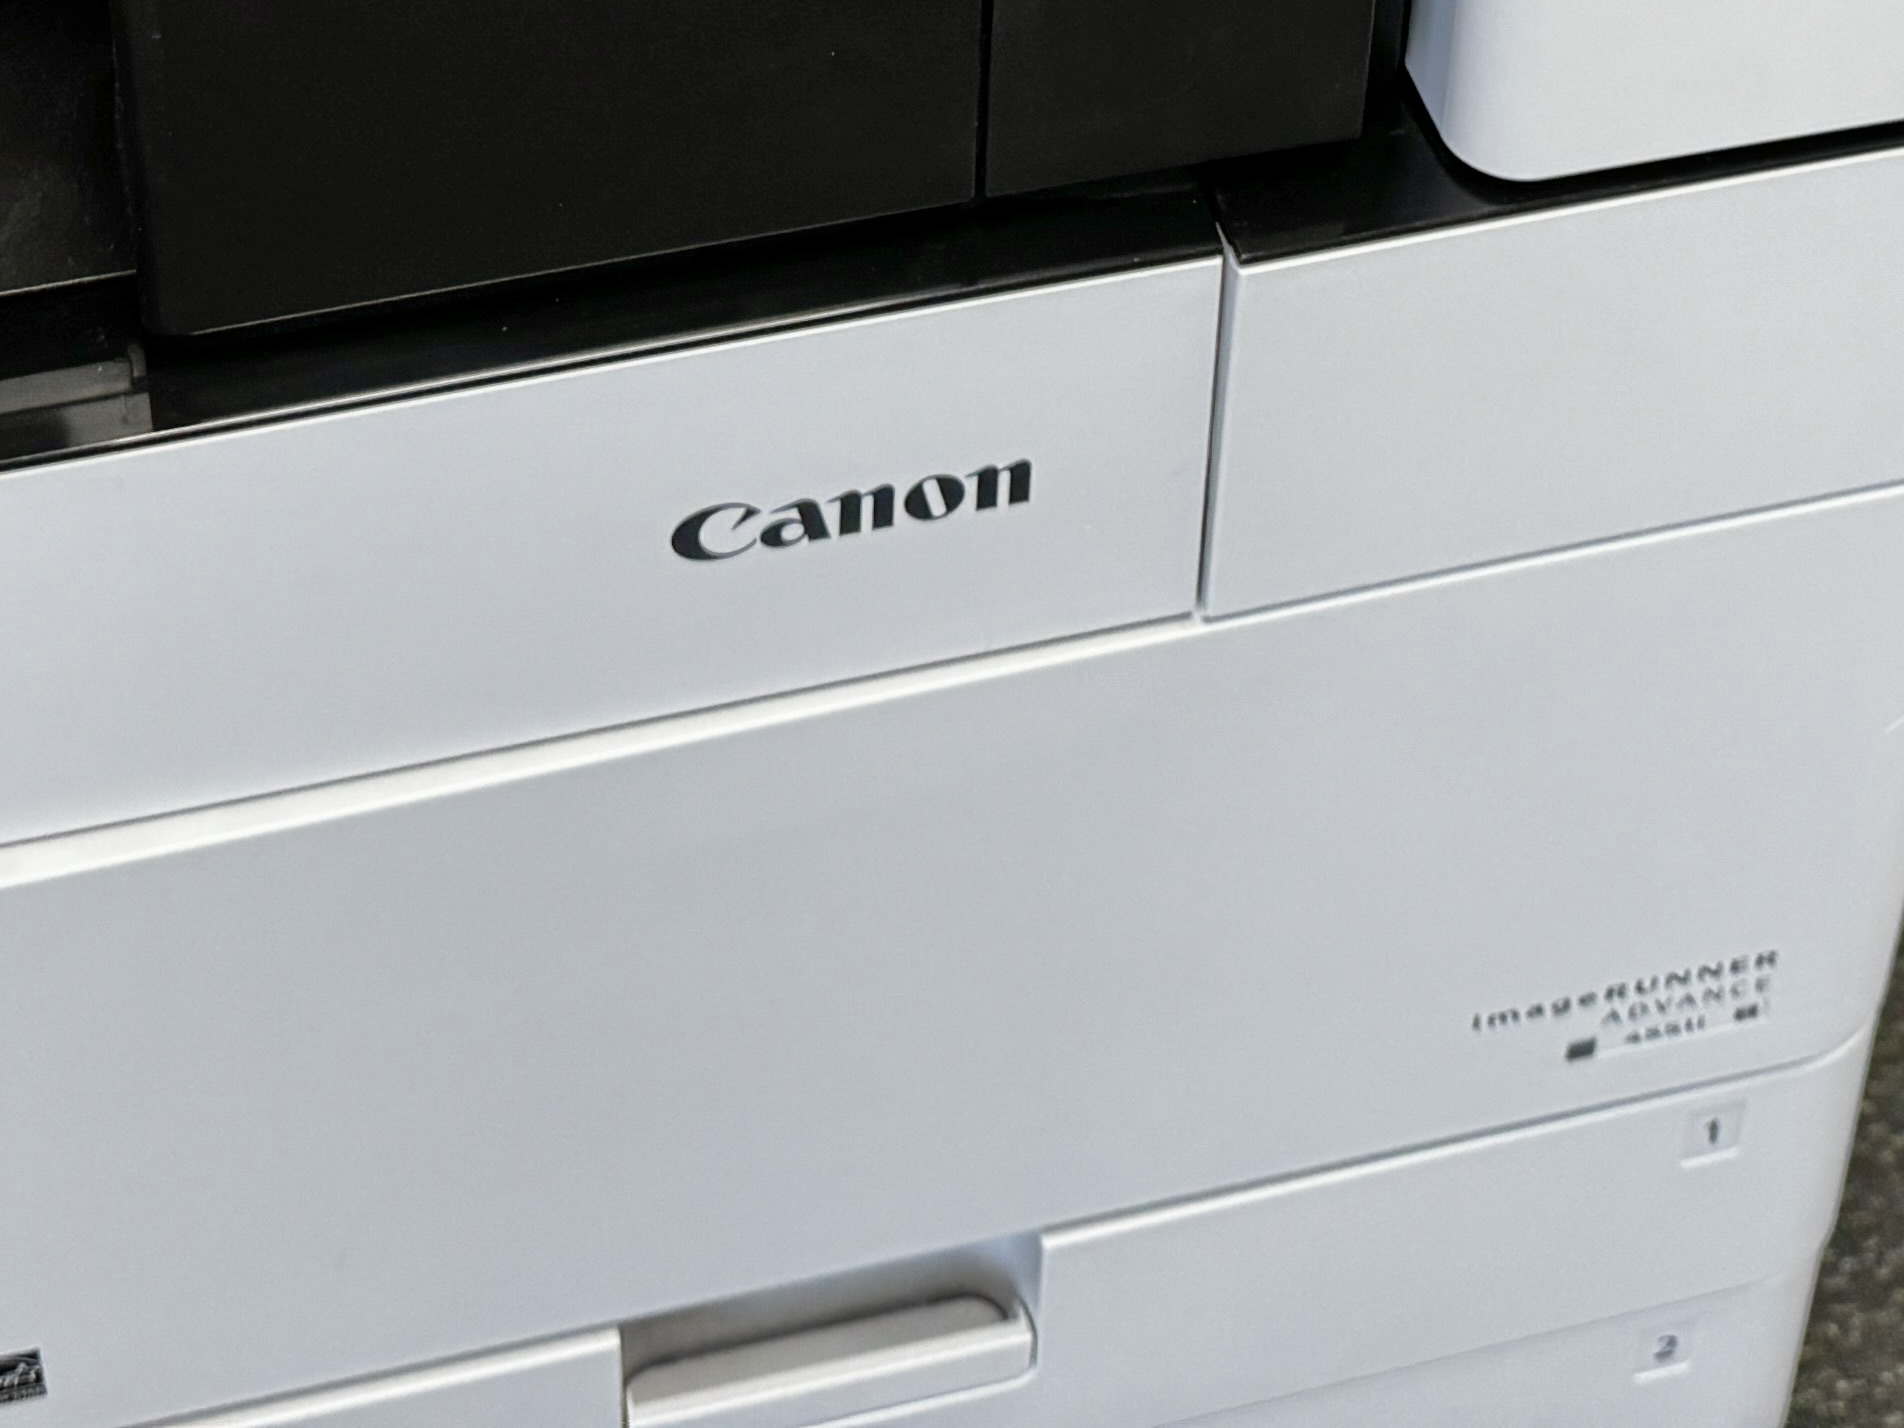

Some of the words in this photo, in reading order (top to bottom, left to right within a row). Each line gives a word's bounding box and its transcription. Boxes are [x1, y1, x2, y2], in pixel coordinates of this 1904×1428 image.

[671, 458, 1032, 561] Canon
[1601, 976, 1772, 1026] ADVANCE
[1654, 1333, 1679, 1362] 2
